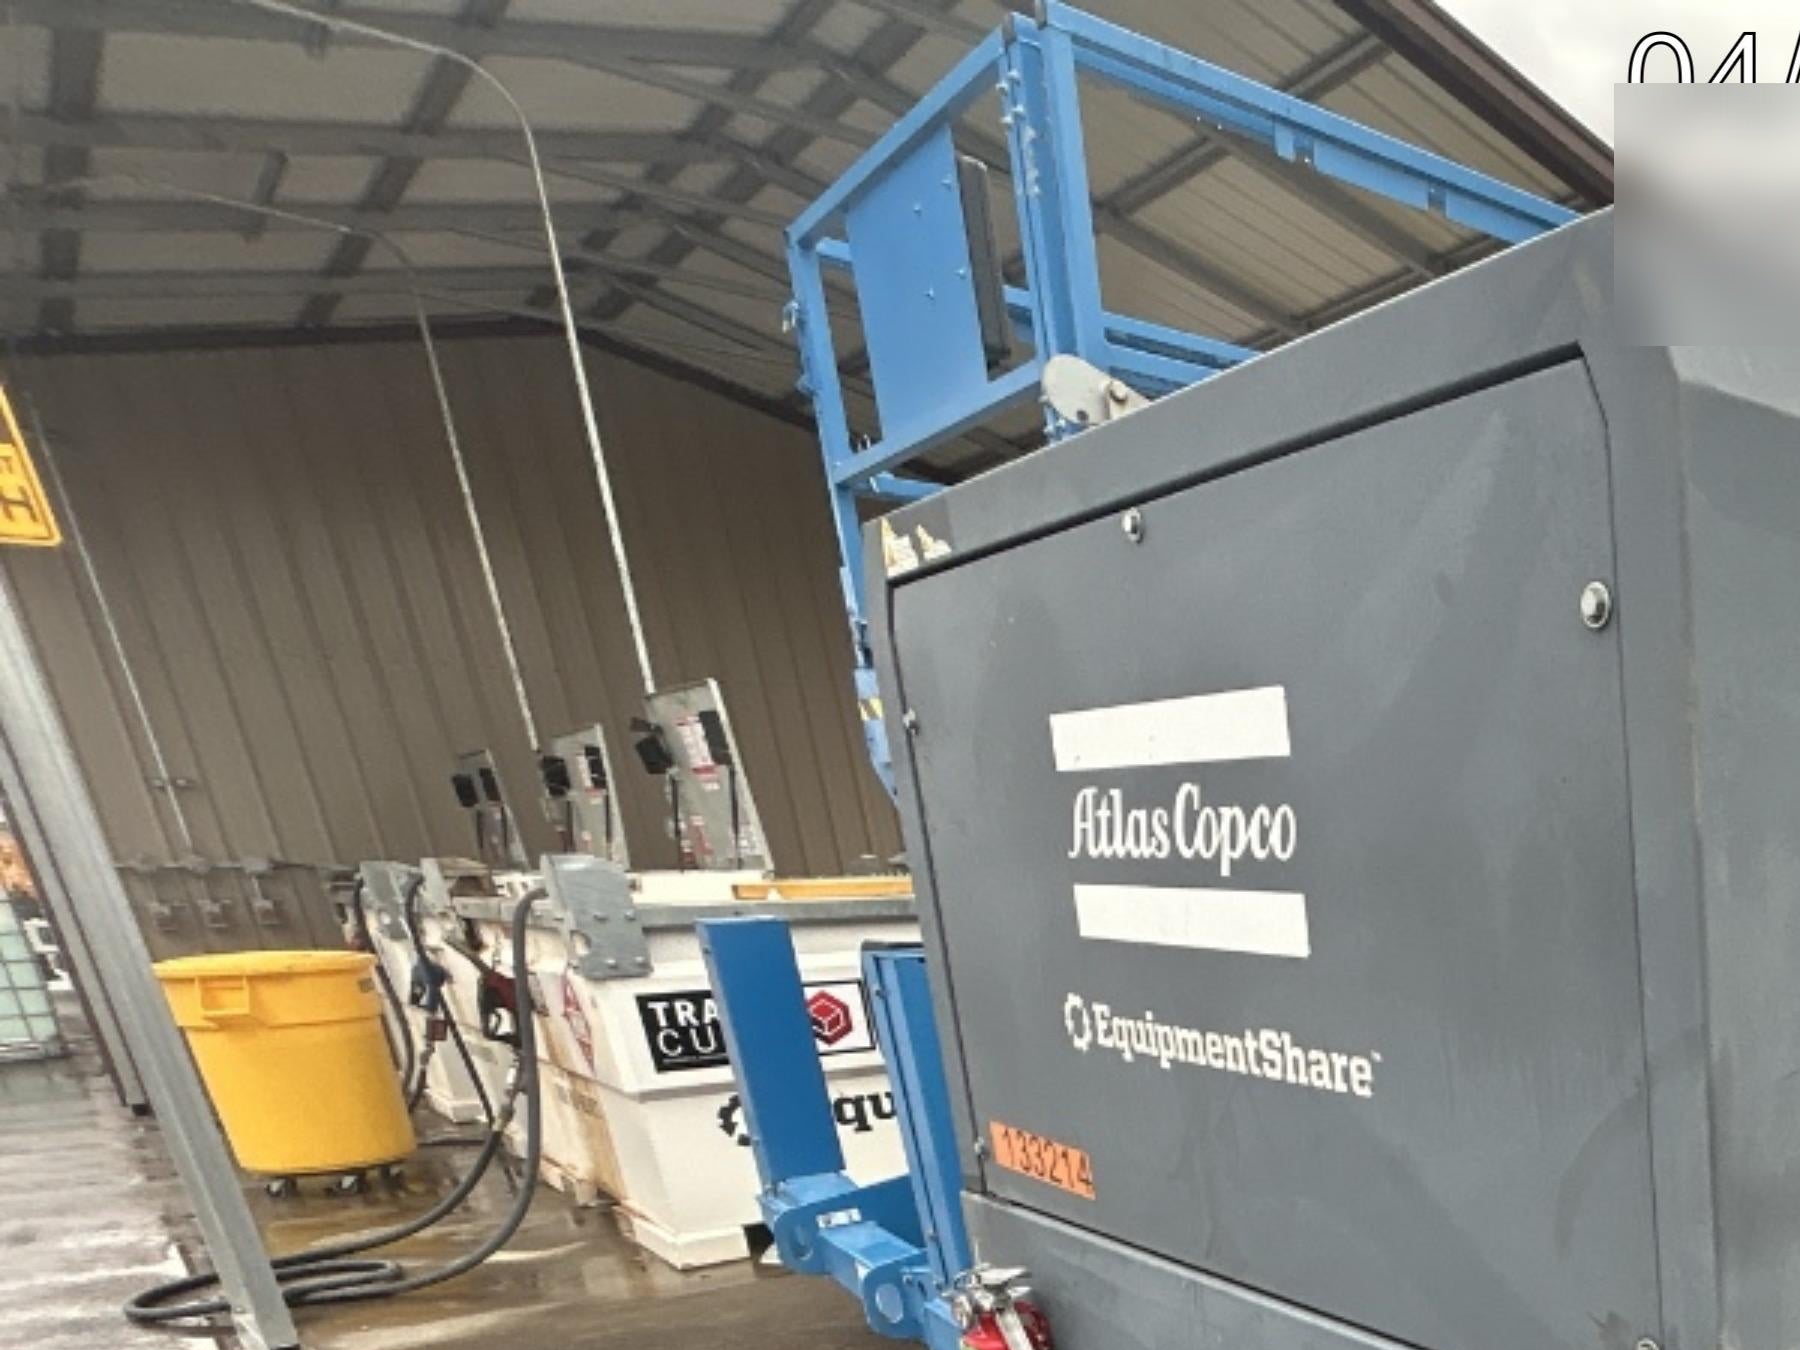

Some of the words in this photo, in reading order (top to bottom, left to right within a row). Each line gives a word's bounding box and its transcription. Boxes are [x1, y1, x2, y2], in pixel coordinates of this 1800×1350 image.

[1068, 784, 1171, 859] Atlas
[1173, 781, 1297, 877] Copco
[1092, 1001, 1374, 1097] EquipmentShare
[1002, 1128, 1093, 1194] 133214
